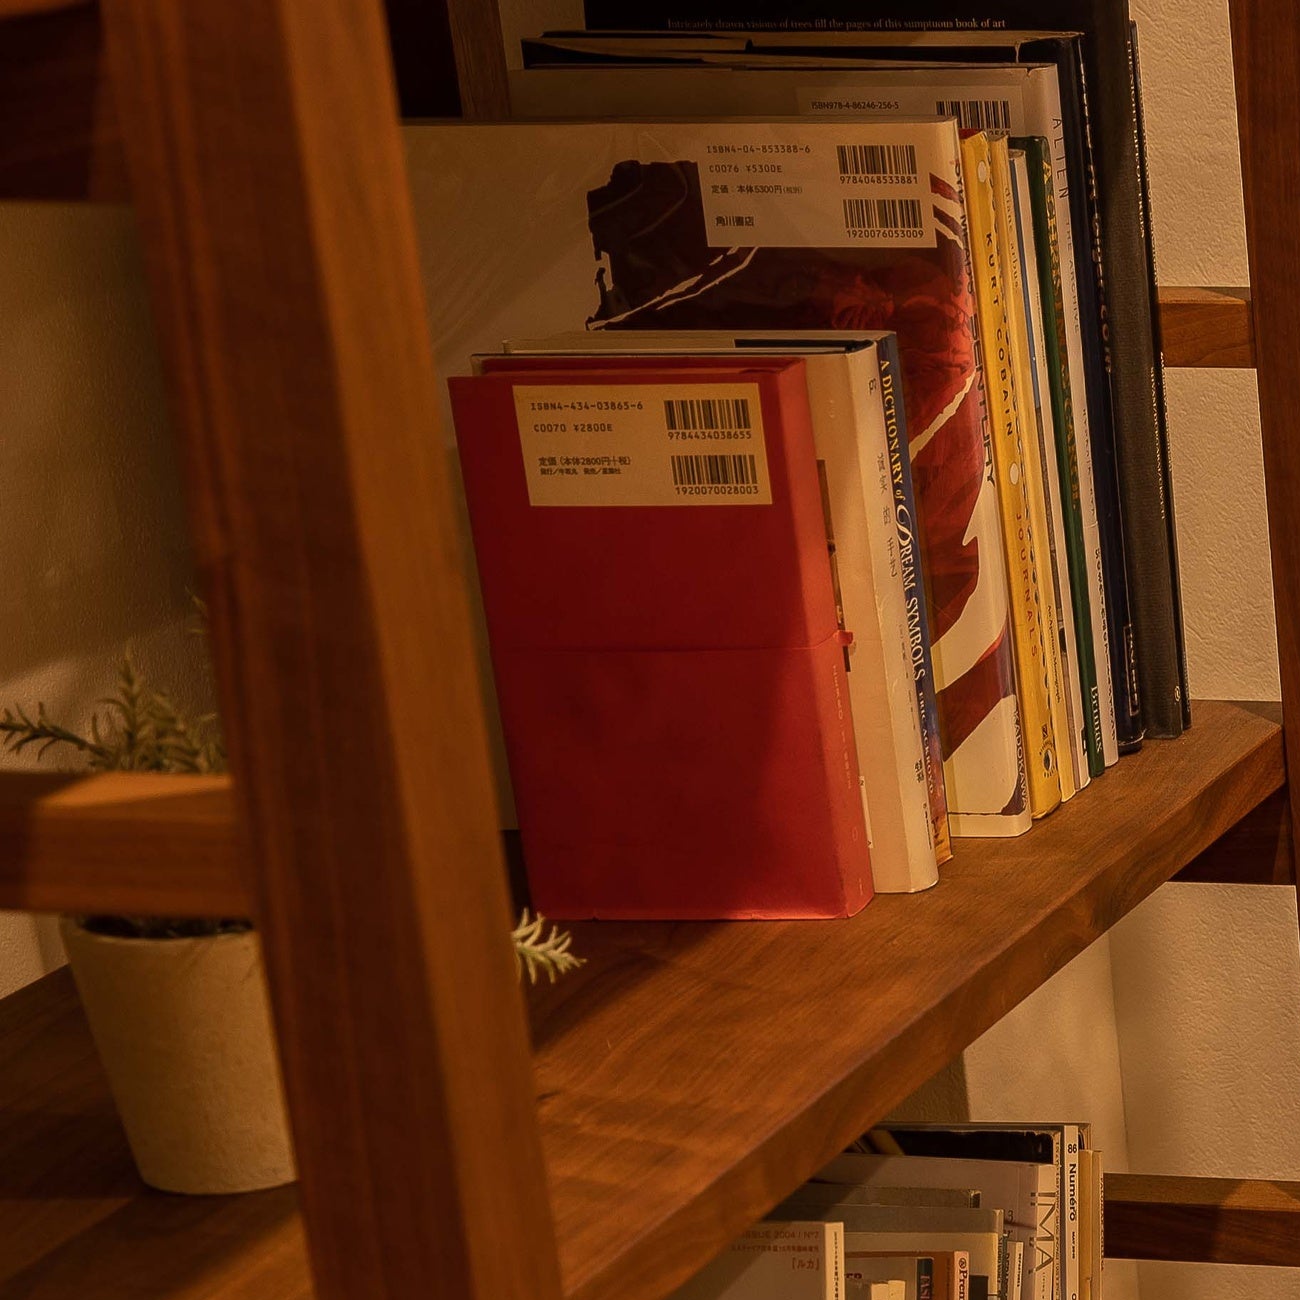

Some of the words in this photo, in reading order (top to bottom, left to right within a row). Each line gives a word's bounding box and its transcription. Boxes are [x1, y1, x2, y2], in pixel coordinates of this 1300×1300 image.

[667, 18, 715, 31] Intricately
[717, 18, 744, 28] drawn
[746, 18, 775, 28] visions
[778, 18, 787, 28] of
[790, 18, 812, 28] trees
[815, 18, 827, 28] fill
[828, 18, 843, 28] the
[845, 18, 871, 31] pages
[873, 18, 883, 28] of
[885, 18, 901, 28] this
[903, 18, 954, 31] sumptuous
[956, 18, 978, 28] book
[980, 18, 991, 28] of
[992, 18, 1006, 28] art
[811, 101, 899, 110] ISBN978-4-86246-256-5
[706, 145, 811, 154] ISBN4-04-853388-6
[1053, 118, 1070, 199] ALIEN
[709, 165, 739, 174] C0076
[839, 176, 918, 185] 9784048533881
[1004, 186, 1013, 231] diane
[715, 216, 754, 226] 角川書店
[846, 229, 924, 239] 1920076053009
[879, 359, 890, 370] A
[531, 402, 643, 411] ISBN4-434-03865-6
[534, 424, 566, 433] C0070
[881, 374, 903, 485] DICTIONARY
[667, 432, 752, 440] 9784434038655
[985, 233, 999, 307] KURT
[997, 328, 1013, 436] COBAIN
[1016, 513, 1037, 658] JOURNALS
[675, 486, 759, 495] 1920070028003
[895, 489, 905, 500] of
[896, 504, 916, 592] DREAM
[906, 597, 926, 681] SYMBOLS
[918, 691, 927, 722] ERIC
[1091, 686, 1103, 752] Brimax
[922, 728, 934, 794] ACKROYD
[1013, 710, 1028, 809] KADOKAWA
[1067, 1143, 1077, 1154] 86
[1068, 1163, 1077, 1221] Numéro
